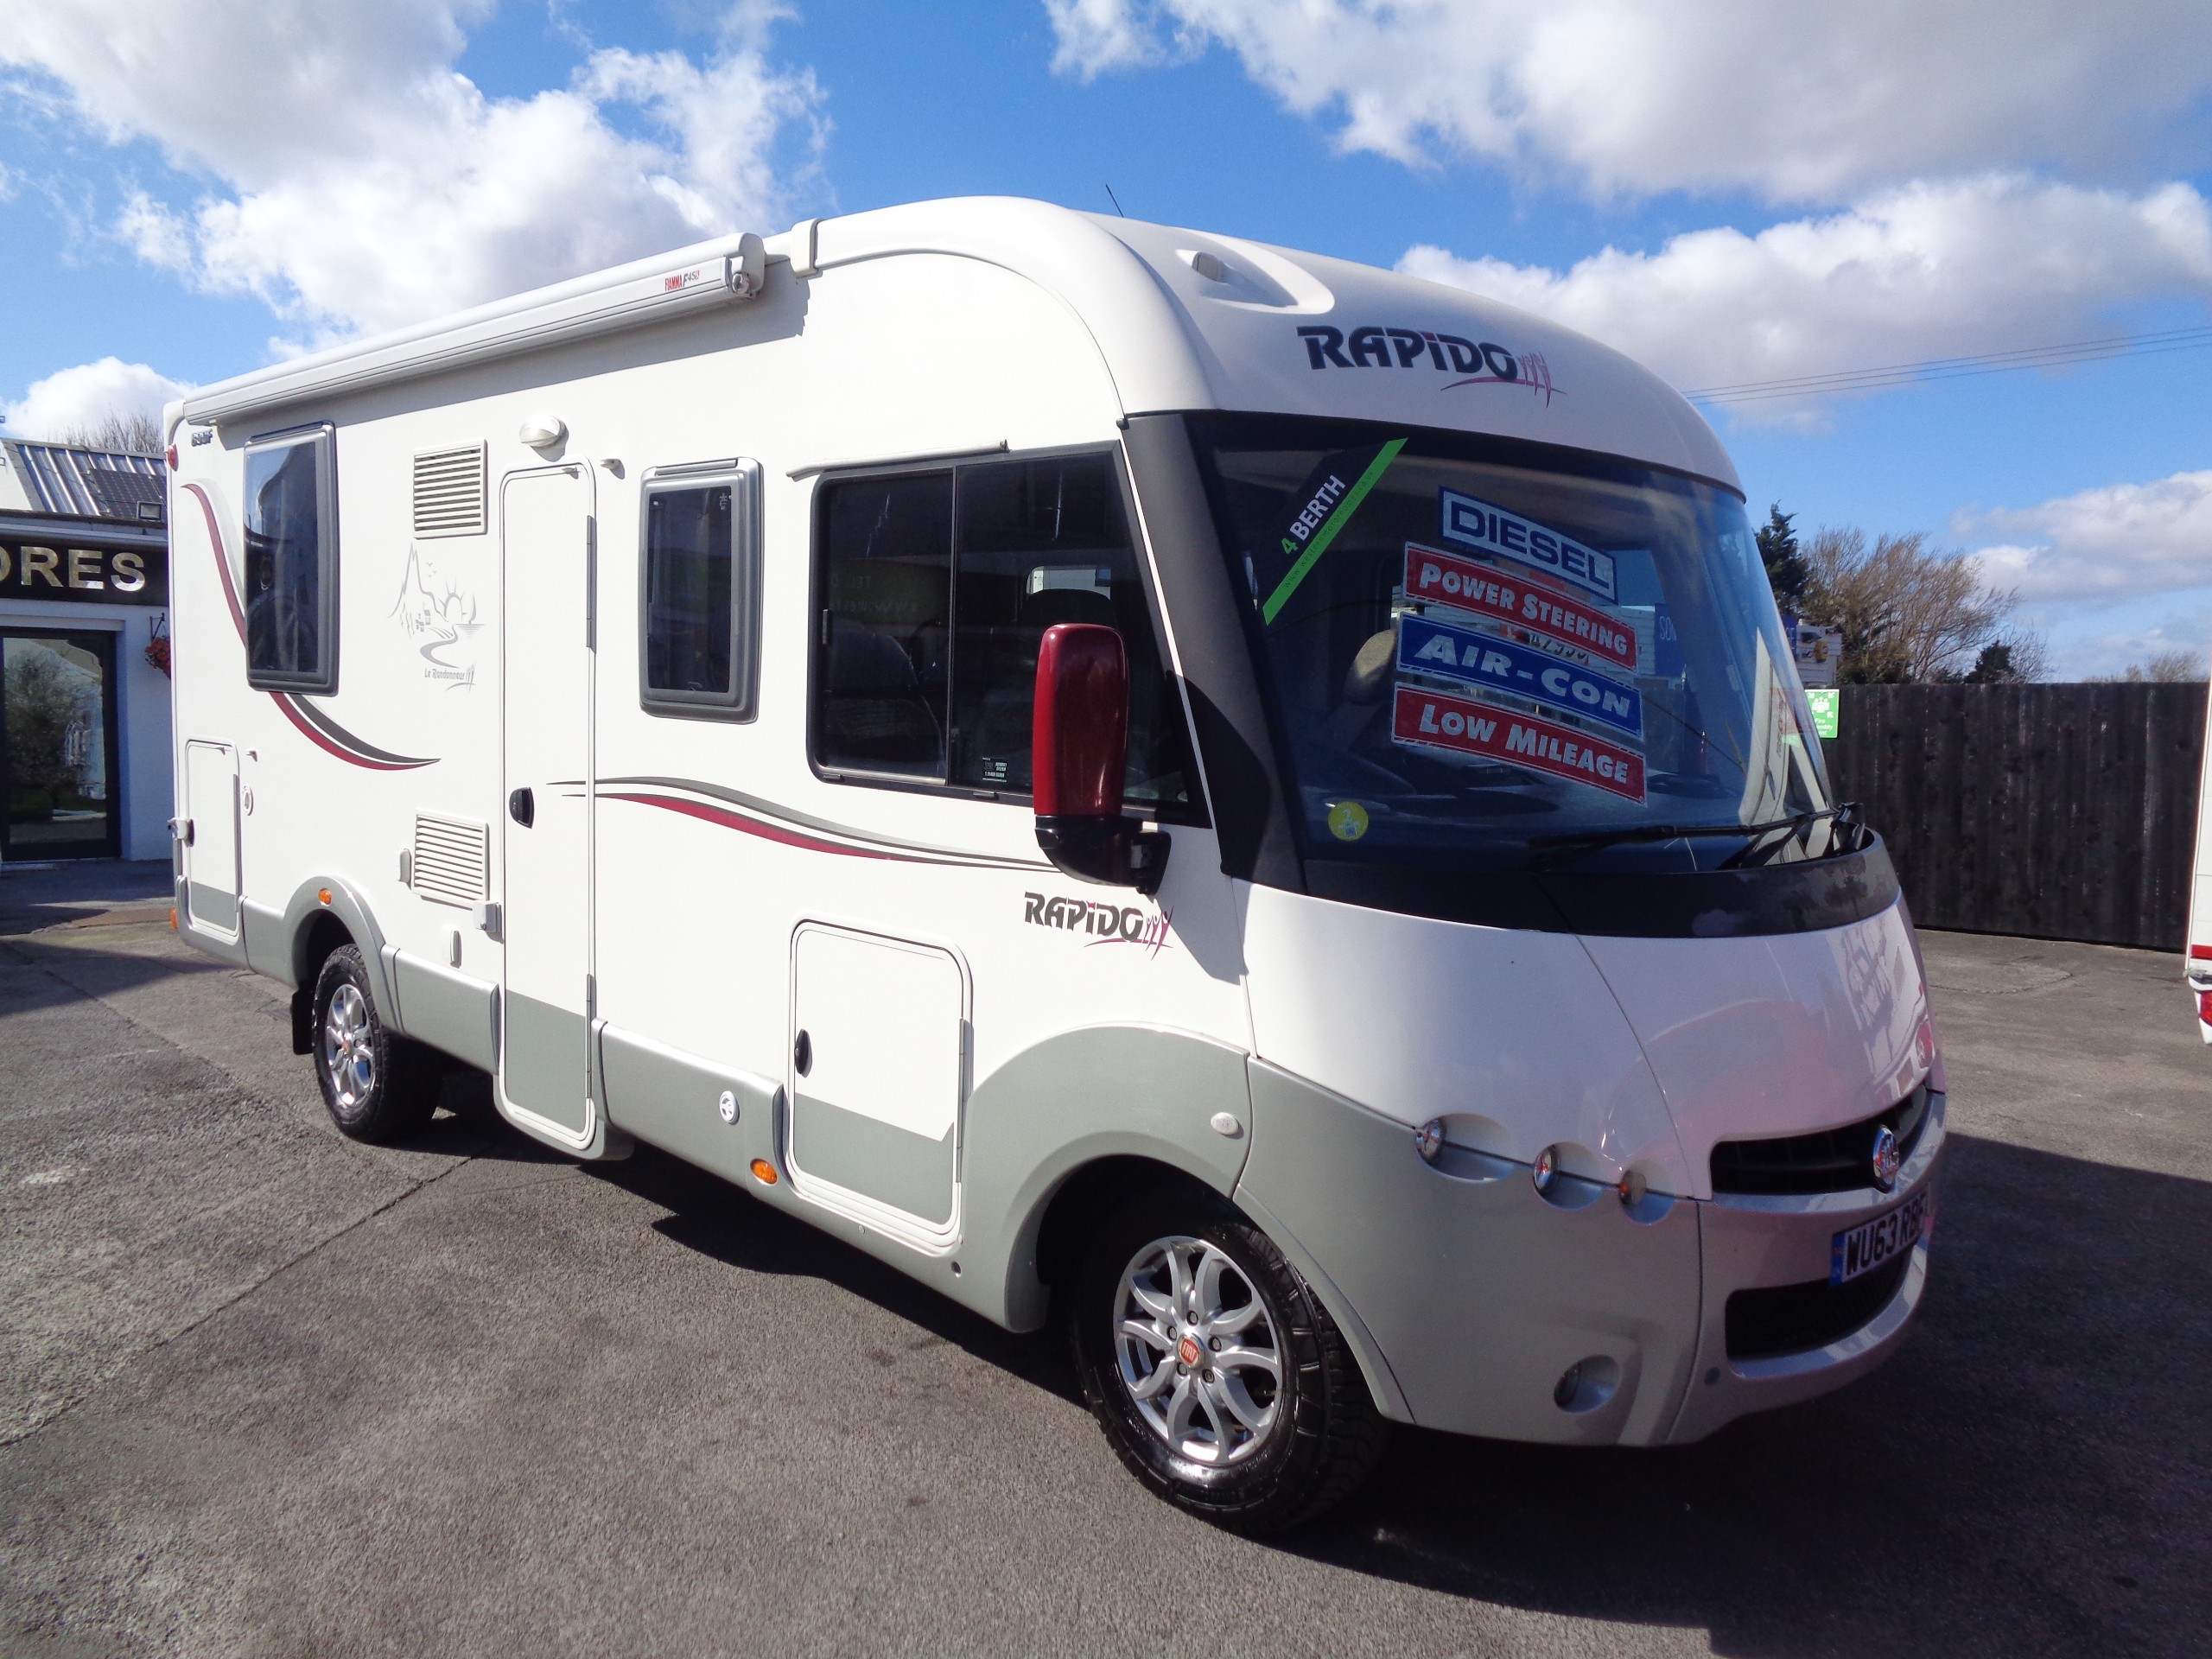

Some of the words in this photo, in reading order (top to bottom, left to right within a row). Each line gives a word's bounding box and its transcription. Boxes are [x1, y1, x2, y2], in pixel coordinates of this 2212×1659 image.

[1289, 474, 1346, 541] BERTH
[0, 546, 146, 592] RES
[1281, 537, 1300, 555] 4
[1450, 500, 1610, 590] DIESEL
[1419, 562, 1516, 612] POWER
[1522, 593, 1628, 657] STEERING
[1414, 634, 1630, 718] AIR-CON
[1419, 703, 1497, 743] LOW
[1504, 724, 1630, 785] MILEAGE
[1846, 1212, 1898, 1276] WU63
[1181, 1341, 1197, 1362] FIAT
